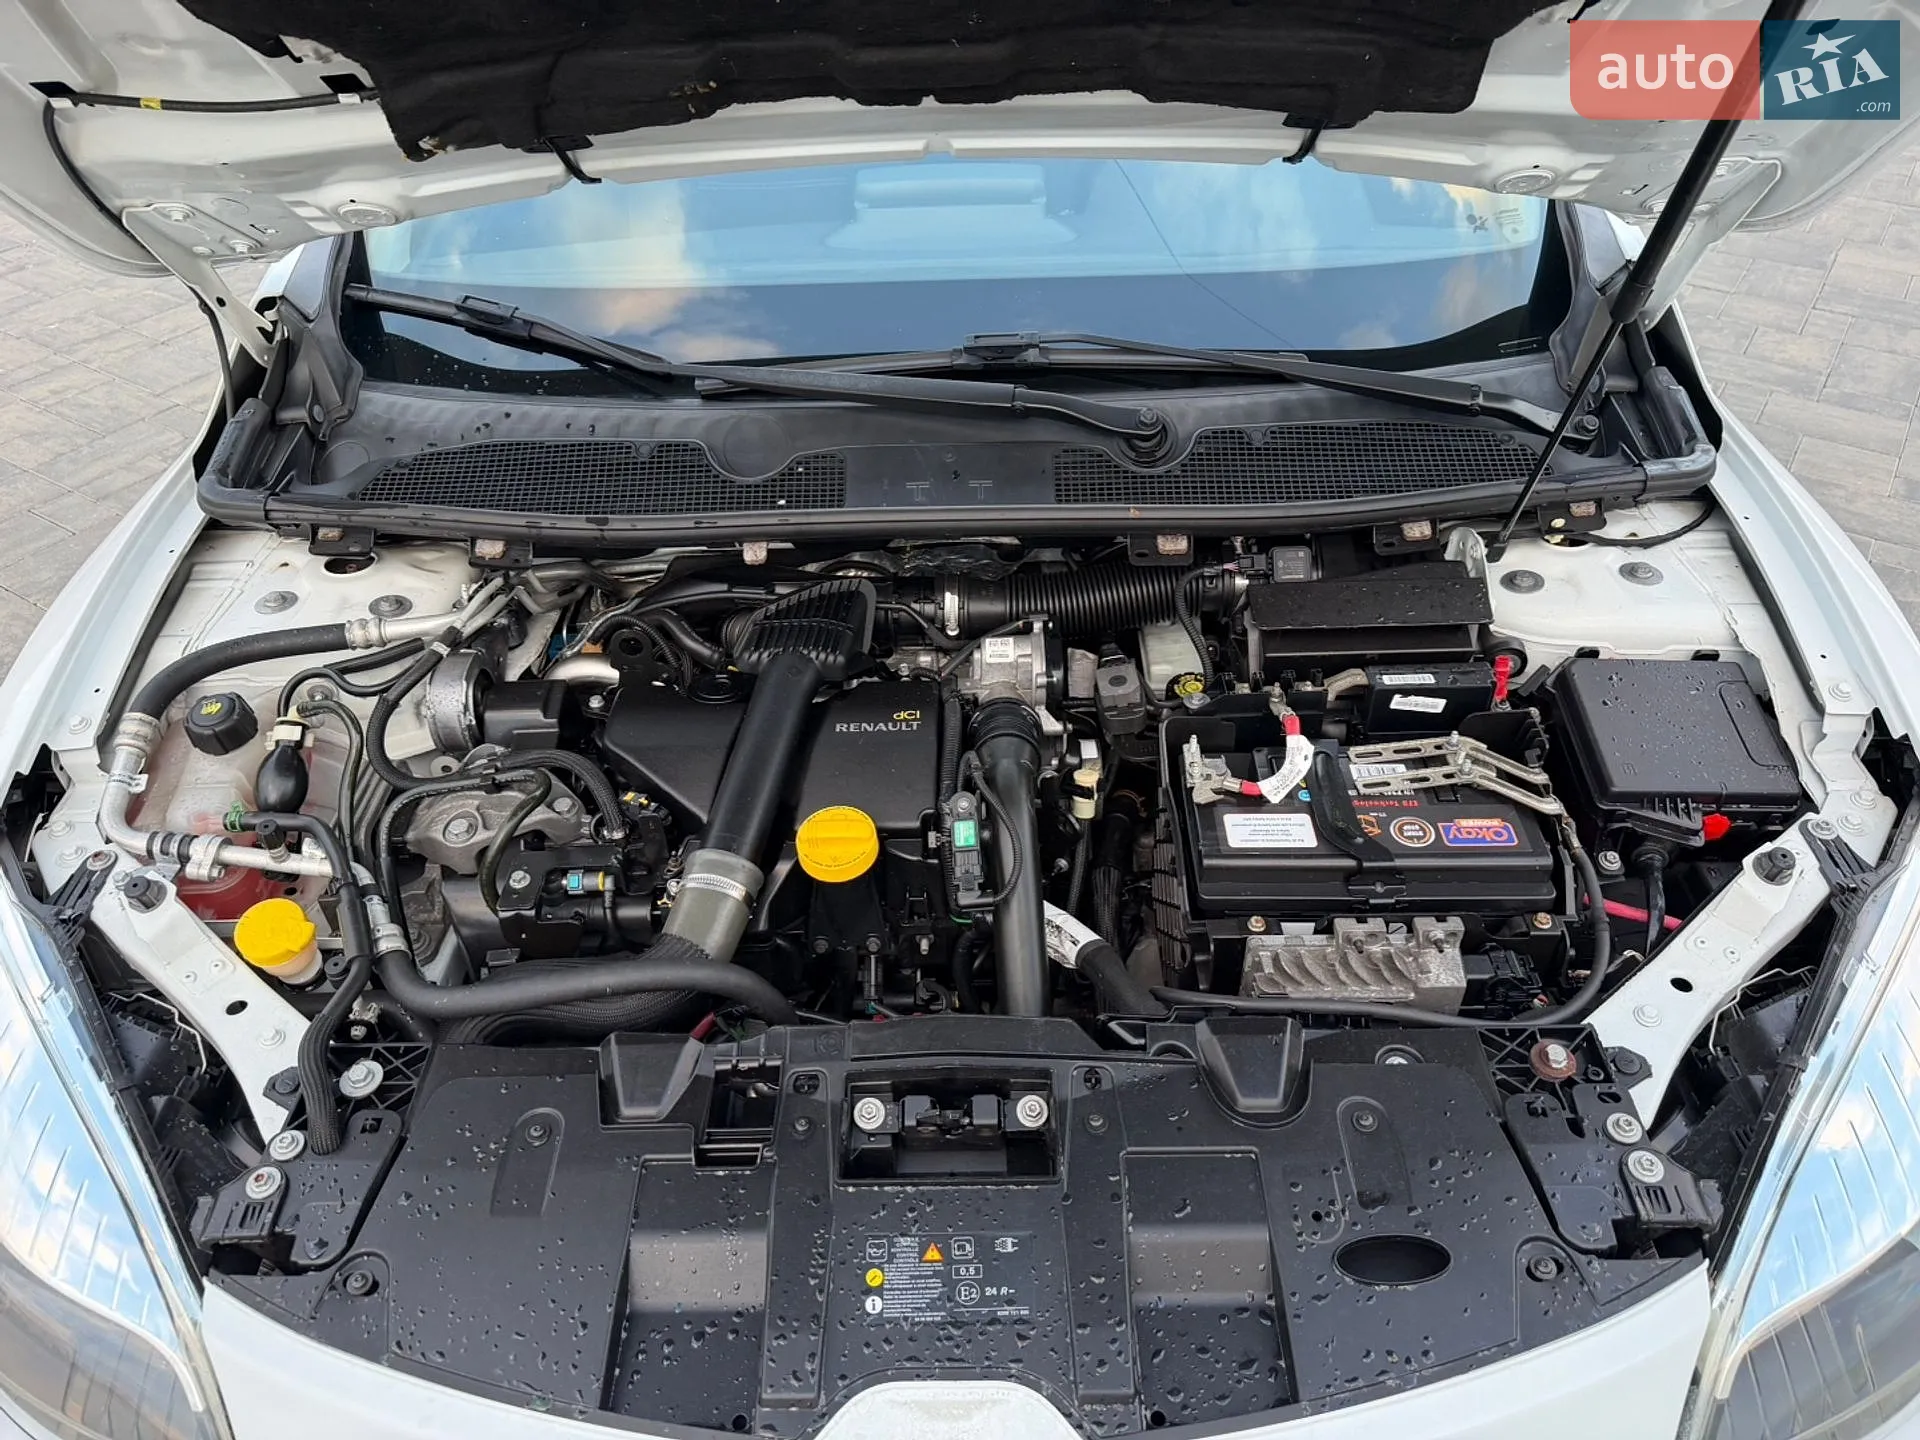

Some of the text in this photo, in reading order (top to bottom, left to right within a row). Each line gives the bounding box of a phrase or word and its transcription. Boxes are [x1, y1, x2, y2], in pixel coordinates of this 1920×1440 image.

[835, 721, 921, 732] RENAULT
[1448, 825, 1509, 842] Okay
[960, 1266, 976, 1276] 0,5
[960, 1286, 978, 1301] E2
[984, 1286, 998, 1296] 24
